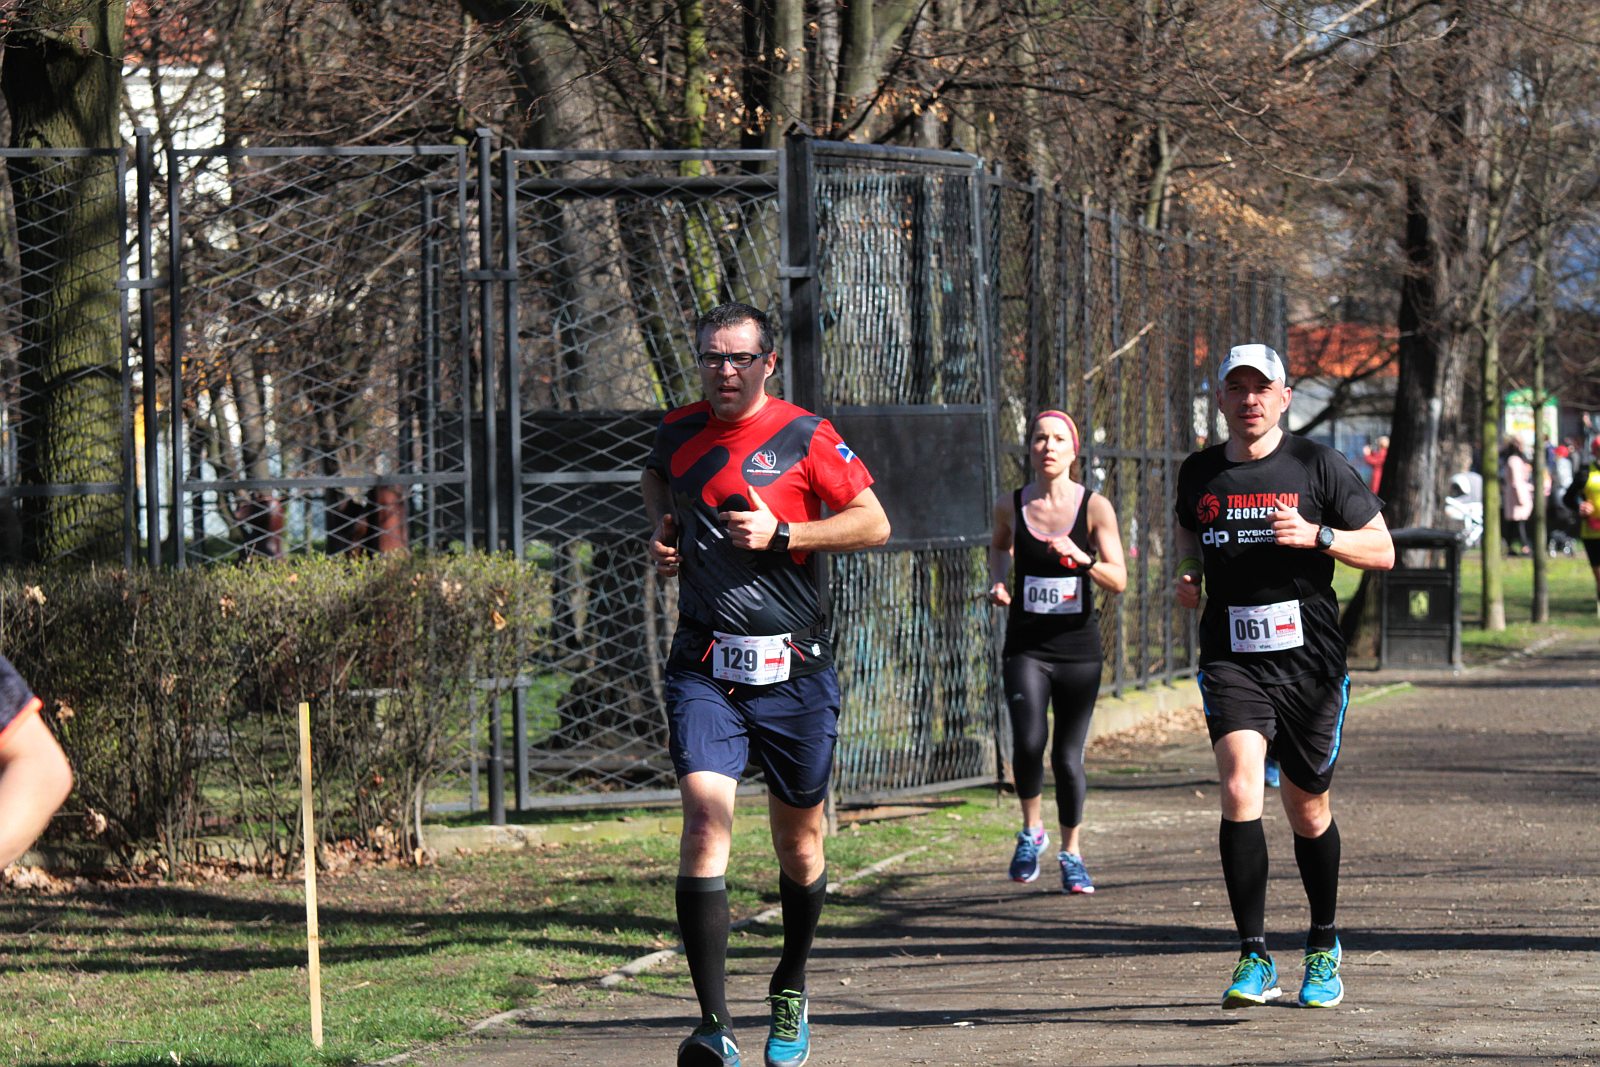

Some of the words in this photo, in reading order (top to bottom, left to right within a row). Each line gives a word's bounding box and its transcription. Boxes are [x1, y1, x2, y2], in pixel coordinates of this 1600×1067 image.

[1227, 493, 1298, 508] TRIATHLON
[1227, 507, 1297, 519] ZGORZE
[1202, 528, 1230, 548] dp
[1237, 529, 1276, 537] DYSKO
[1028, 586, 1059, 604] 046
[1234, 618, 1271, 640] 061
[720, 646, 758, 671] 129
